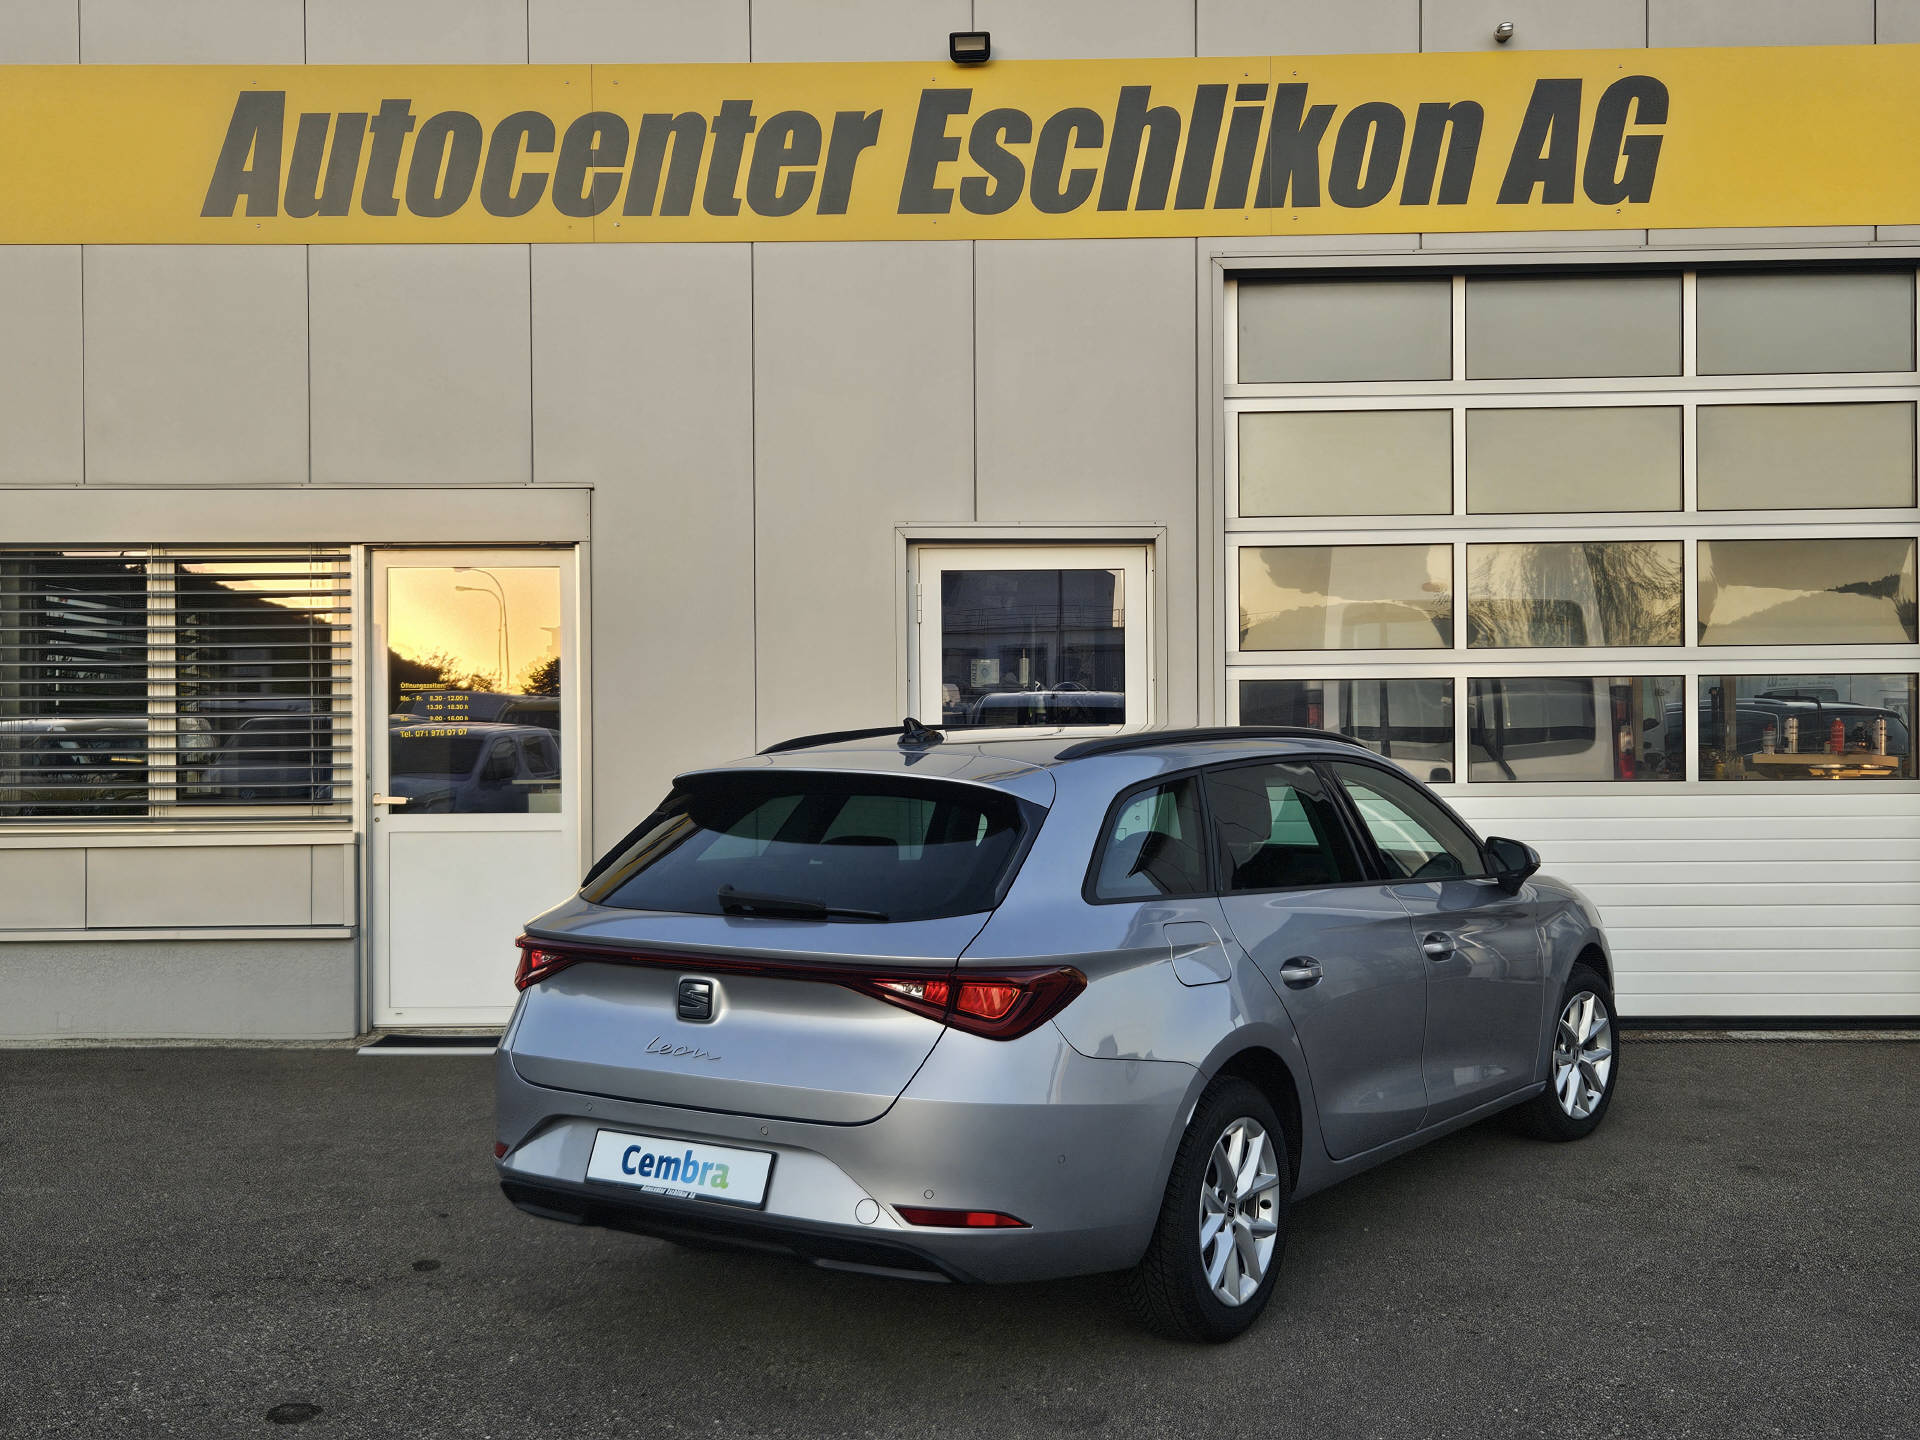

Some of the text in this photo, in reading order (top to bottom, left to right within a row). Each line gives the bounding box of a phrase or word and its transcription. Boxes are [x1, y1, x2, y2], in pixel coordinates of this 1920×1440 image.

[200, 75, 1669, 218] Autocenter Eschlikon AG
[400, 730, 413, 738] Tel.
[458, 728, 467, 736] 07
[645, 1034, 722, 1061] Leon
[622, 1144, 730, 1190] Cembra
